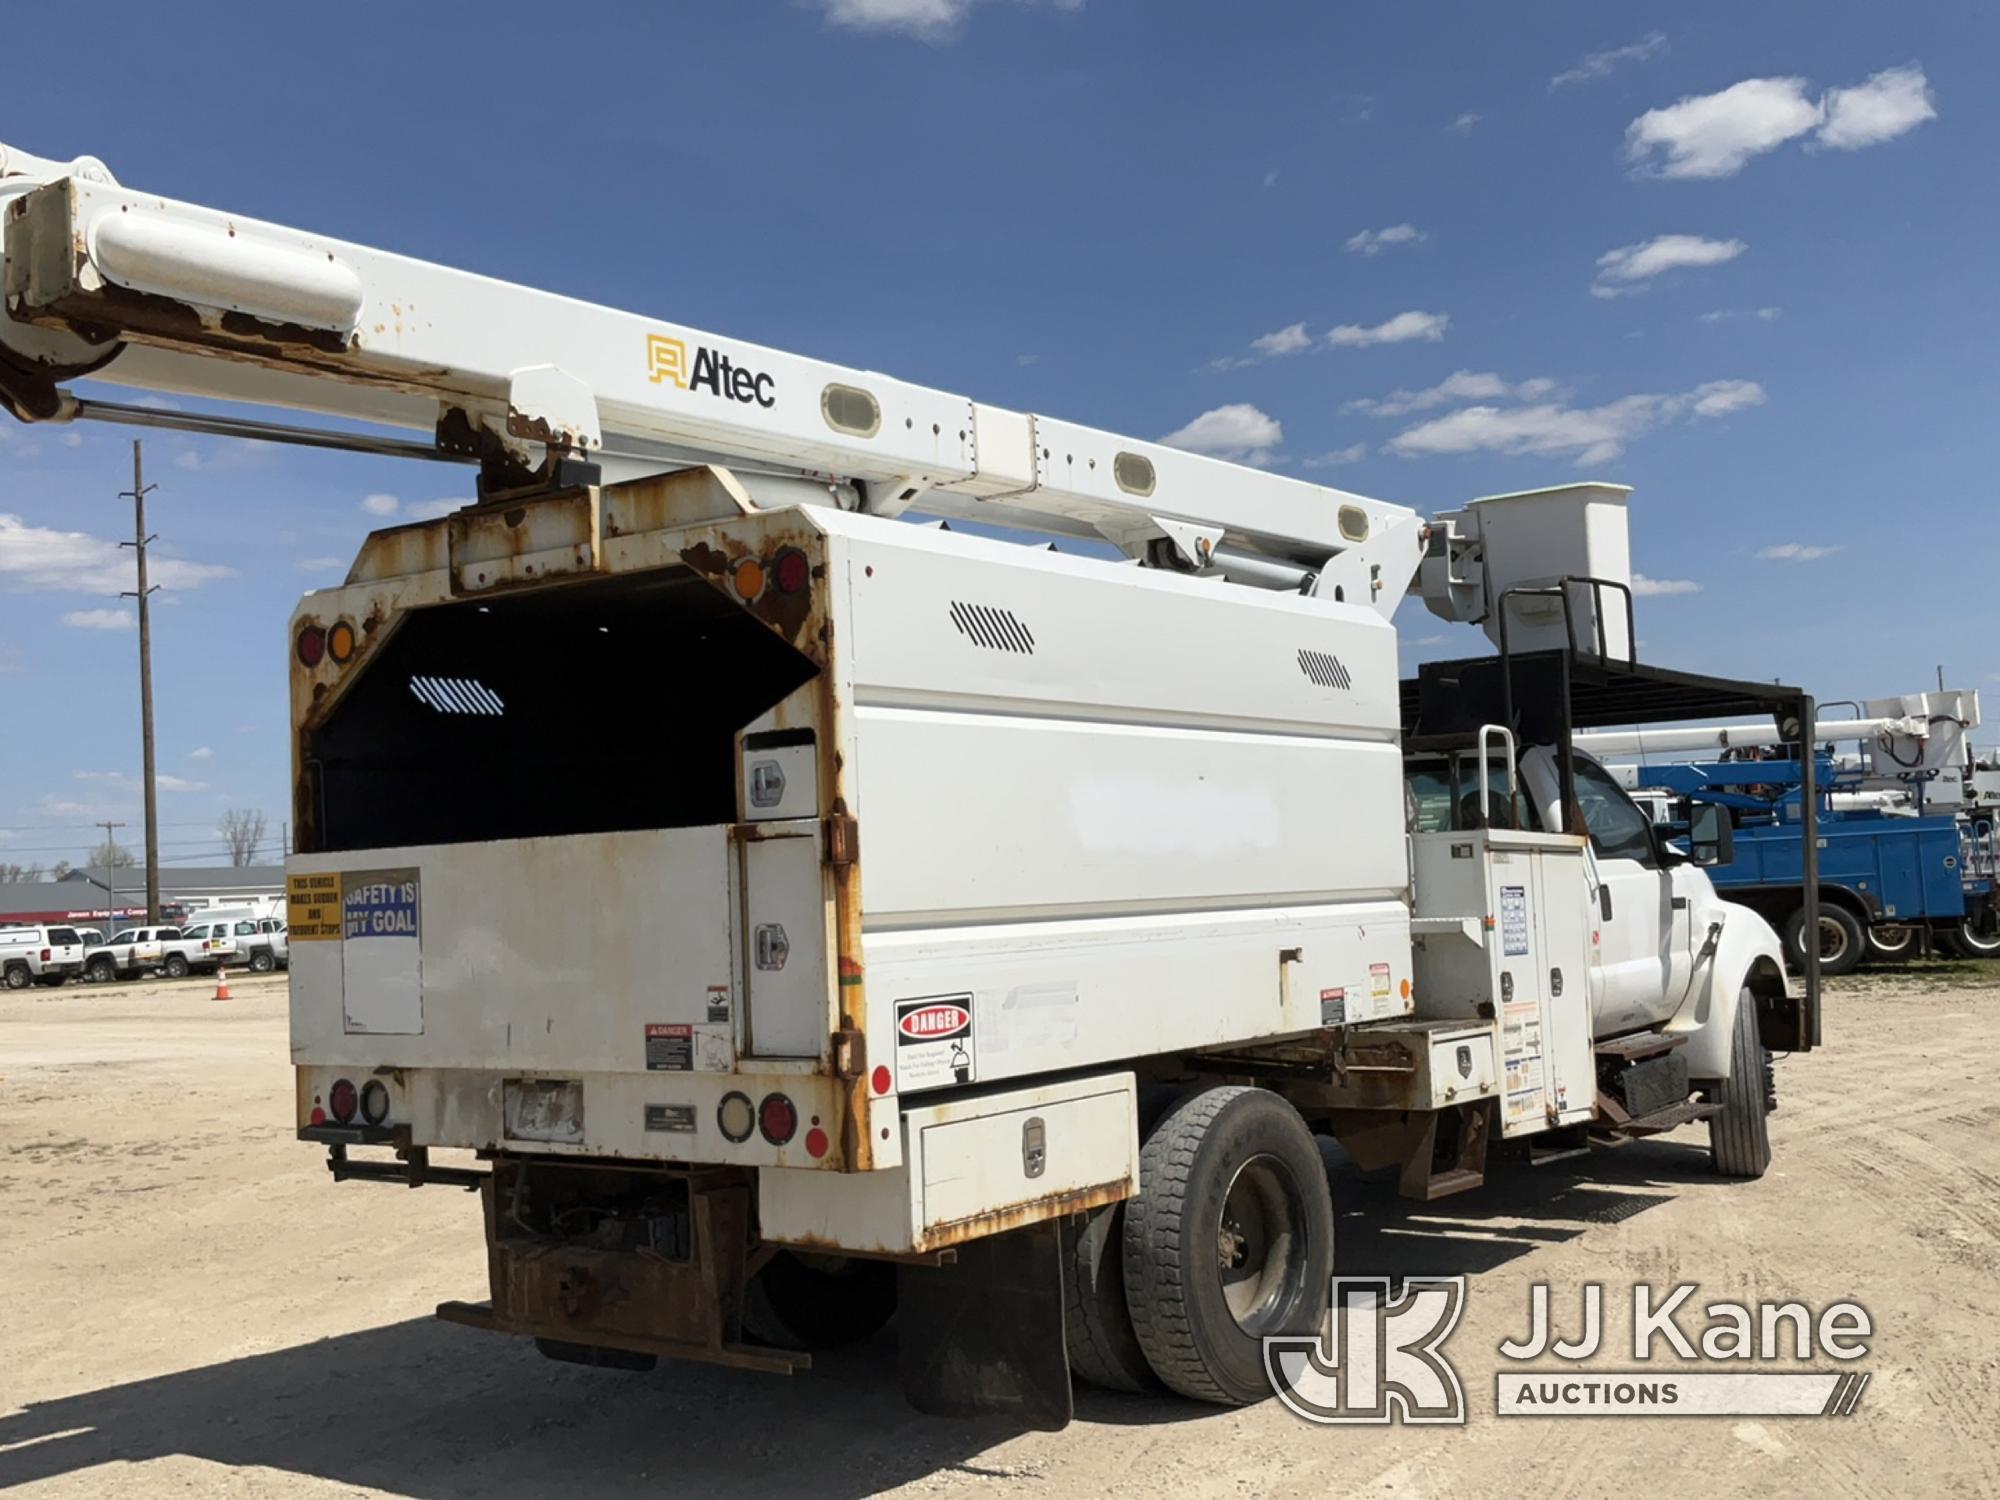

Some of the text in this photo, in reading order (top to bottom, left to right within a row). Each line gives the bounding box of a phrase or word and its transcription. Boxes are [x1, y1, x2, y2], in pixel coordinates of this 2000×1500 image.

[689, 346, 776, 408] Altec
[401, 881, 414, 903] IS
[308, 908, 320, 919] AND
[373, 909, 415, 932] GOAL
[657, 1025, 688, 1036] DANGER
[911, 1009, 959, 1033] DANGER
